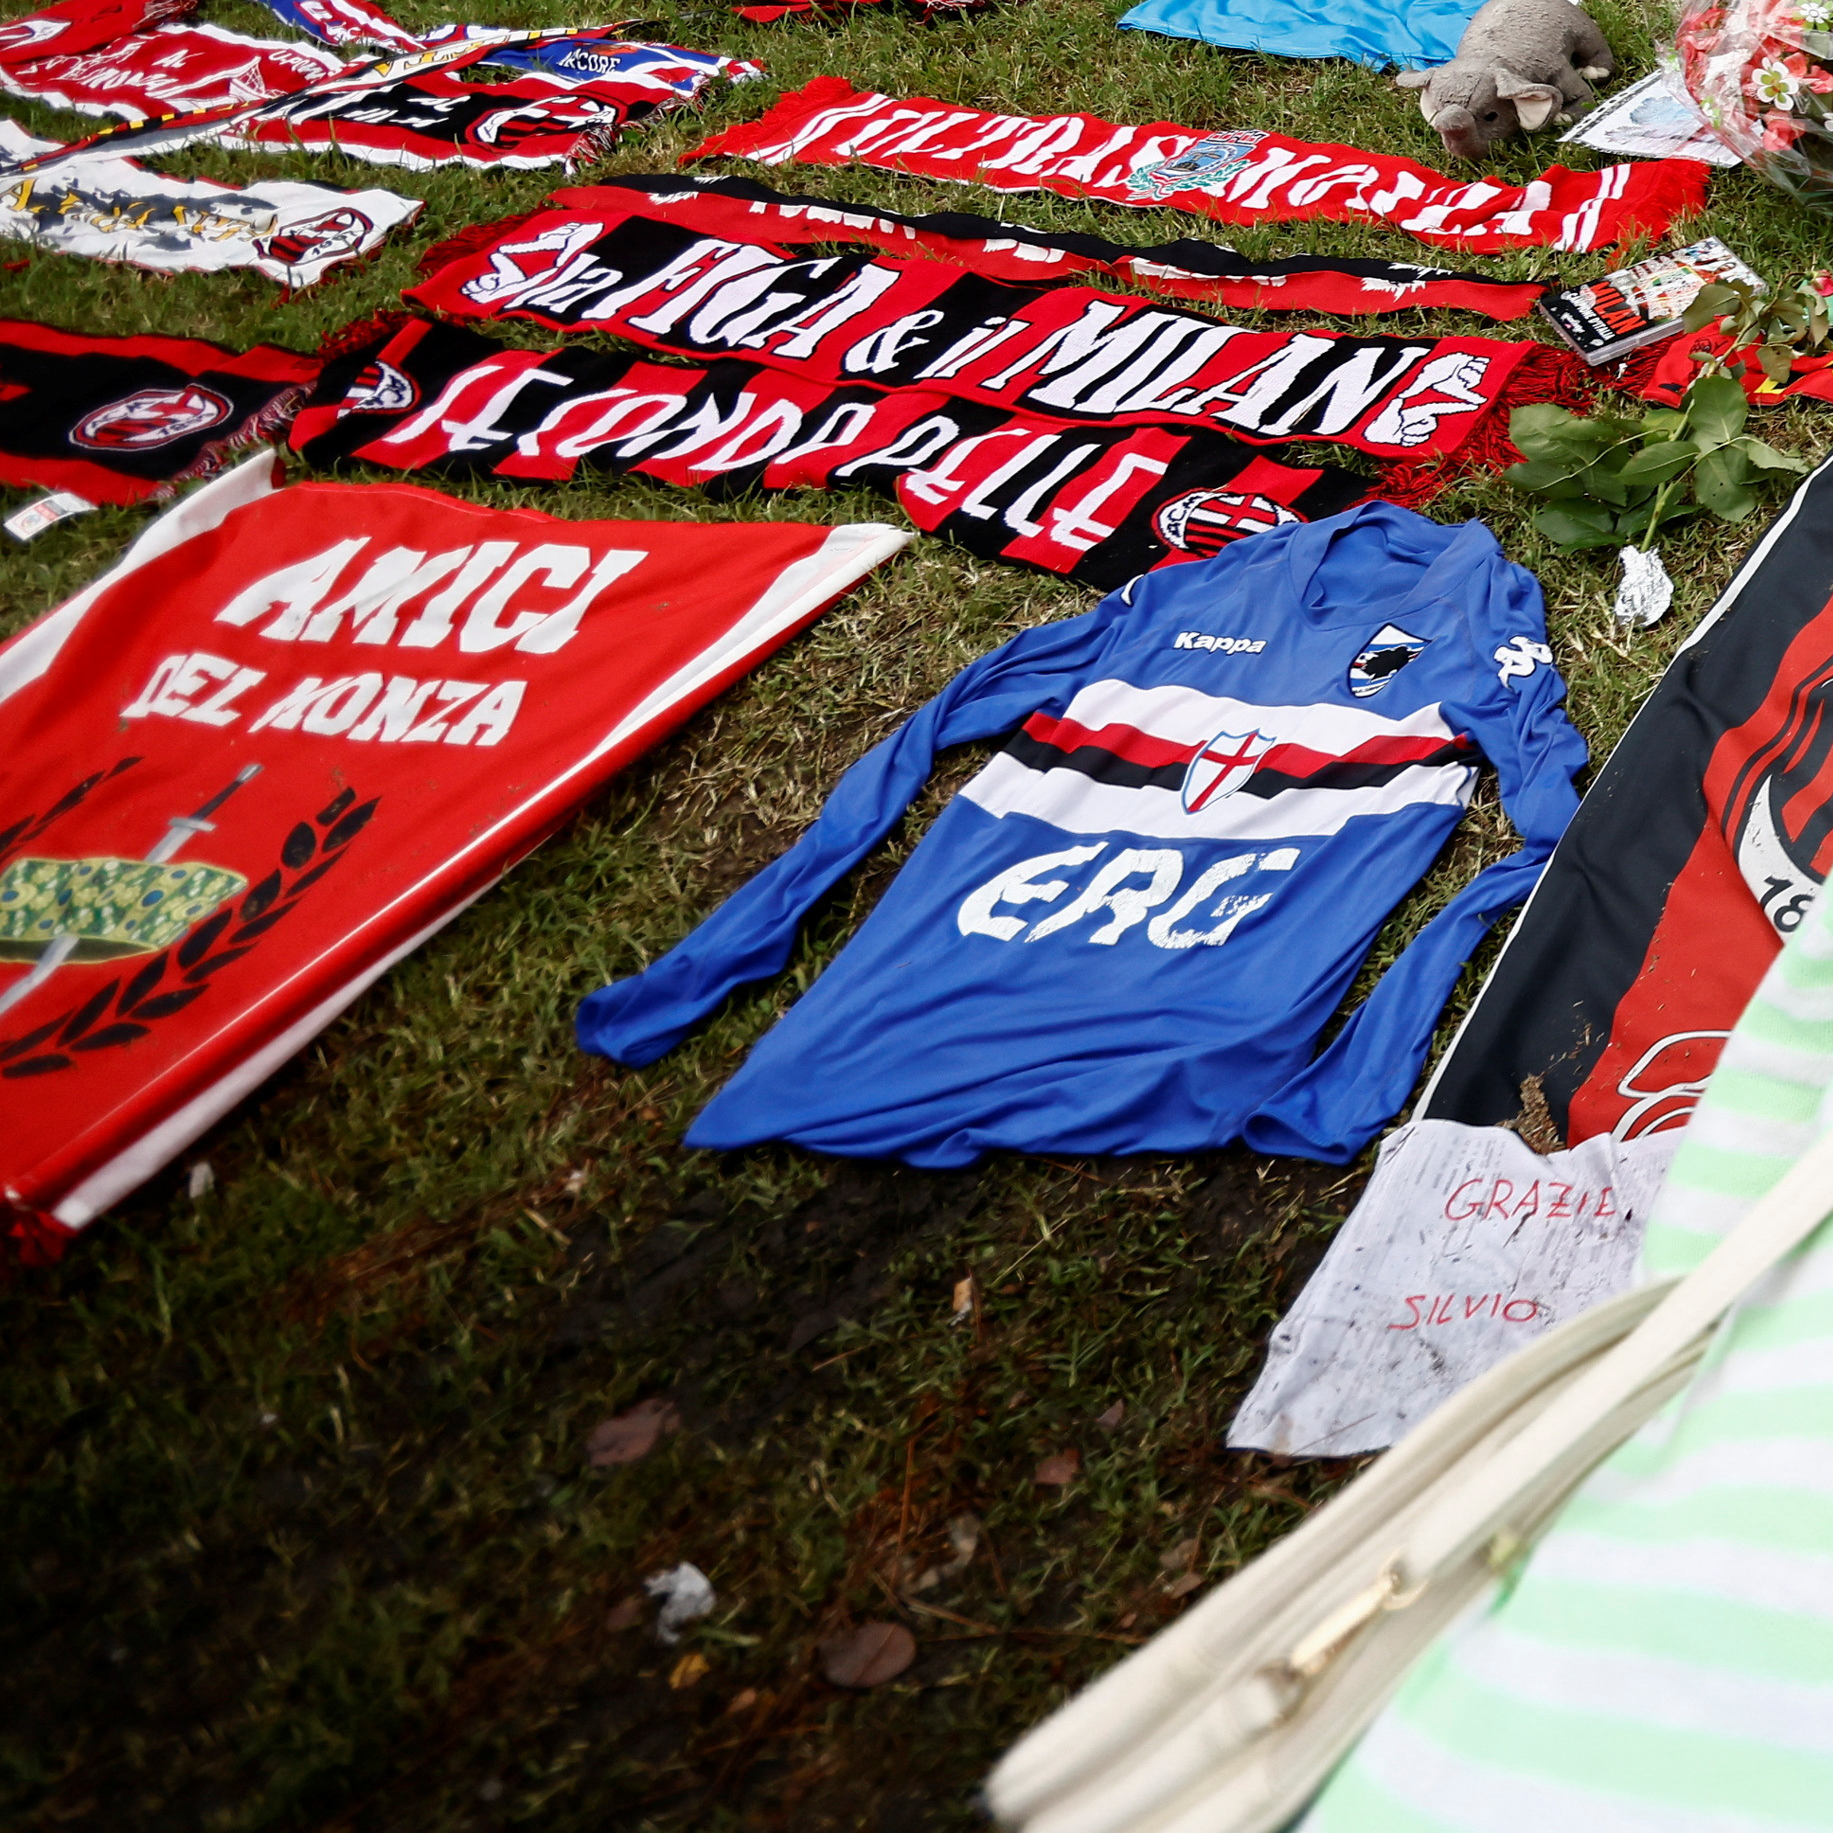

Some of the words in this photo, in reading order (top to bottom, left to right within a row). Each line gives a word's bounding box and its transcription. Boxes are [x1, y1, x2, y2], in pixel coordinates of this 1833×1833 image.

[505, 252, 624, 320] la
[627, 237, 901, 360] FIGA
[843, 309, 944, 374] &
[914, 316, 1031, 392] il
[1026, 299, 1431, 438] MILAN
[1588, 280, 1647, 335] MILAN
[213, 536, 651, 655] AMICI
[1173, 628, 1267, 656] Kappa
[119, 652, 268, 727] DEL
[249, 672, 530, 748] MONZA
[956, 840, 1300, 950] ERG
[1756, 874, 1818, 936] 18
[1441, 1176, 1619, 1222] GRAZIE
[1387, 1292, 1541, 1332] SILVIO
